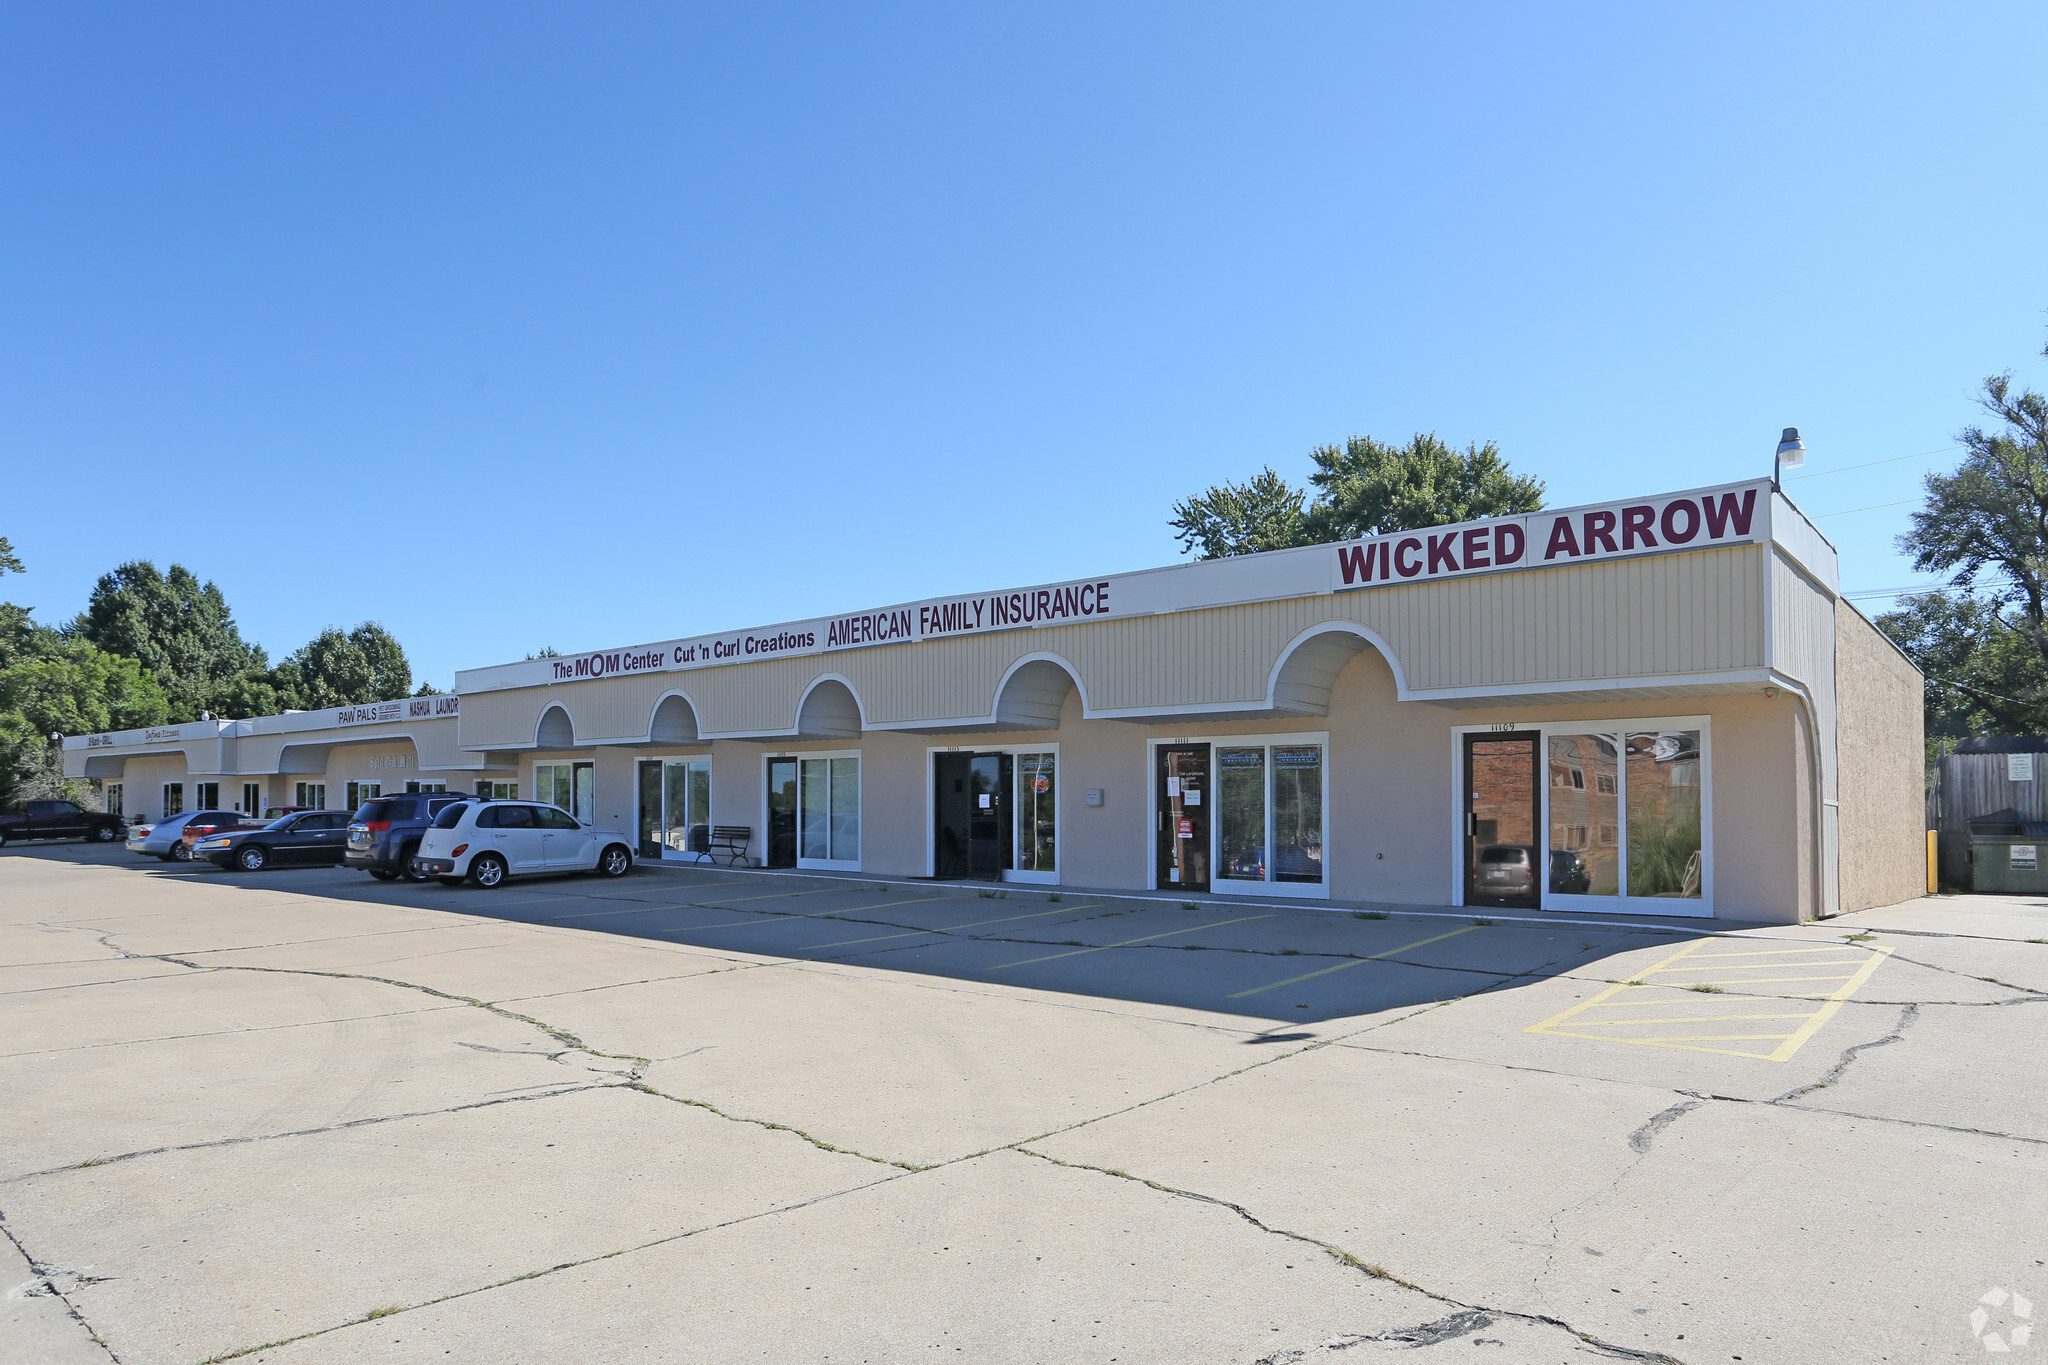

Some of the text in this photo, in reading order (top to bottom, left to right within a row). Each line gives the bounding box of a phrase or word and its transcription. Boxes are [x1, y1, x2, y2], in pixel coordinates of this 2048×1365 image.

[1337, 489, 1758, 585] WICKED ARROW
[827, 581, 1110, 647] AMERICAN FAMILY INSURANCE
[674, 631, 815, 664] Cut 'n Curl Creations
[553, 651, 664, 679] The MOM Center
[357, 707, 377, 722] PALS
[409, 700, 430, 717] NASHUA
[1491, 722, 1514, 732] 11109
